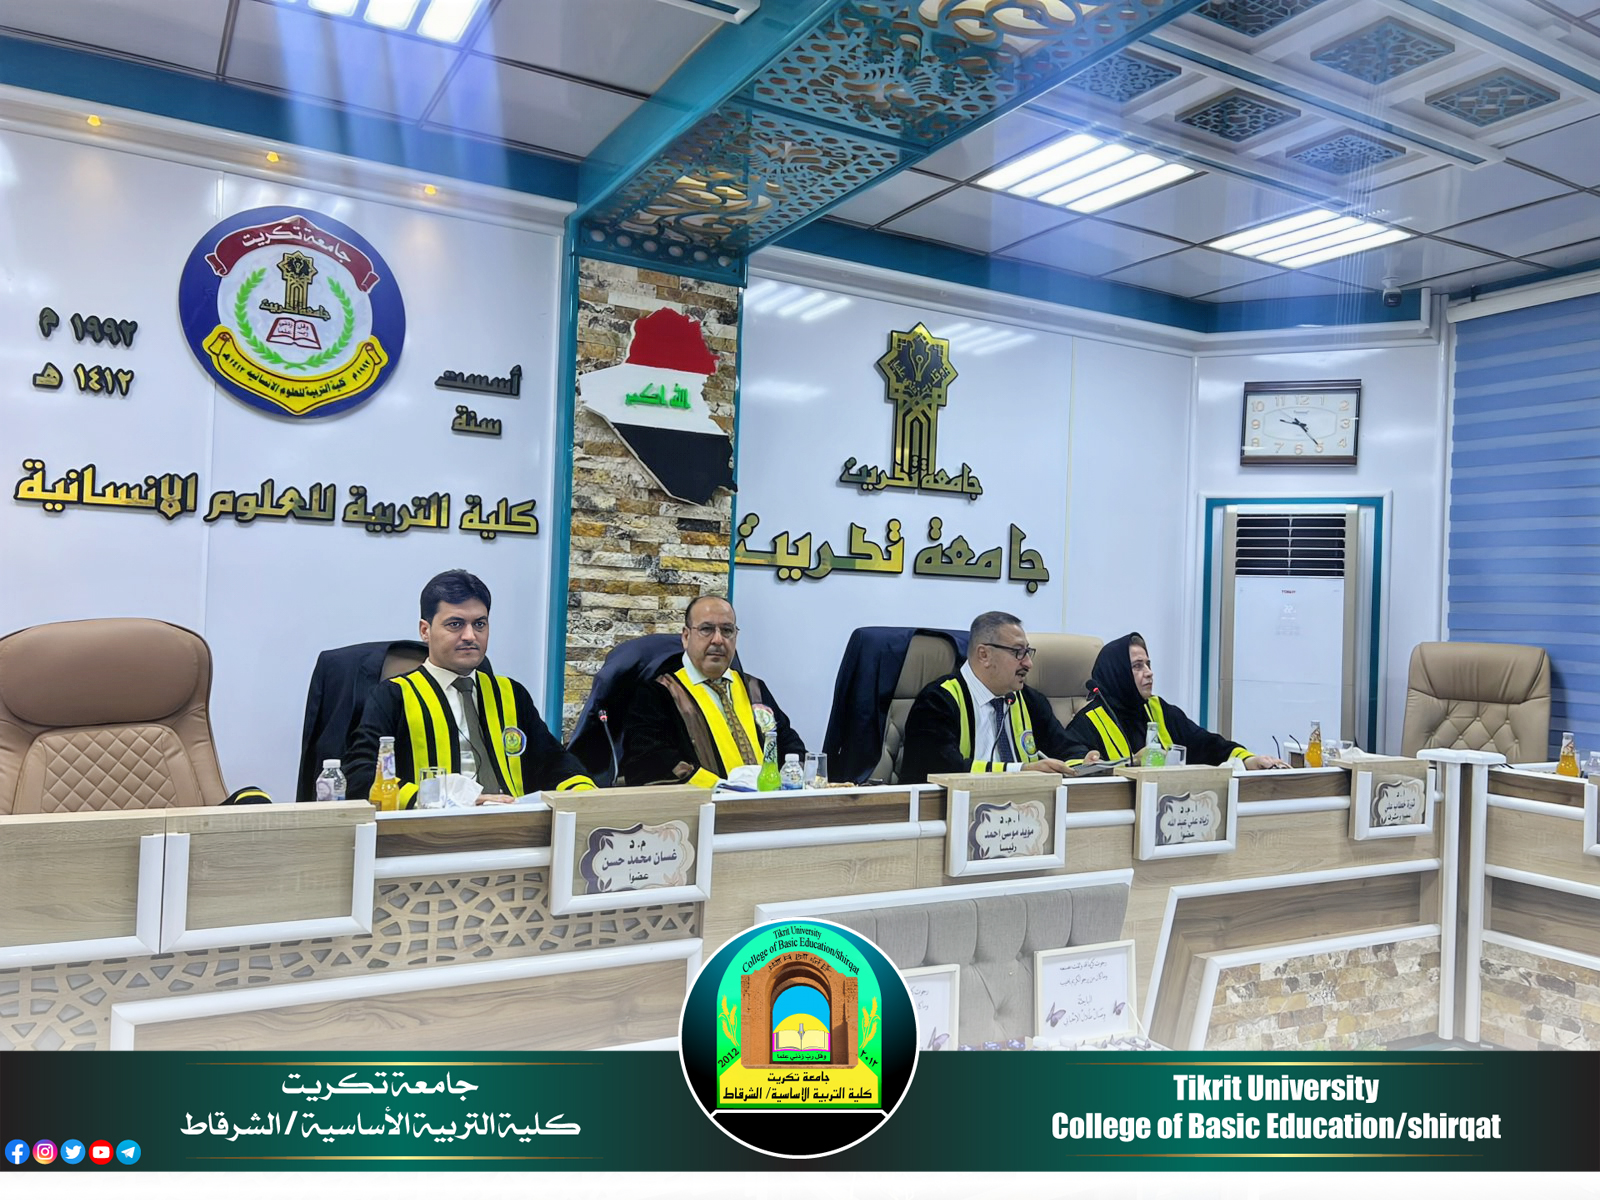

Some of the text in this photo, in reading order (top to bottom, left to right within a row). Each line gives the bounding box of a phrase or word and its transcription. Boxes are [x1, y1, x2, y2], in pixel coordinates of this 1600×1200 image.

[242, 225, 351, 263] جامعة تكريت
[39, 306, 138, 347] ١٩٩٢ م
[73, 362, 135, 397] ١٤١٢
[669, 382, 692, 409] الله
[451, 405, 502, 435] سنة
[1340, 418, 1350, 430] 3
[839, 455, 983, 501] جامعة تكريت
[13, 458, 539, 540] كلية التربية للعلوم الانسانية
[734, 512, 1050, 593] جامعة تكريت
[602, 849, 678, 871] غسان محمد حسن
